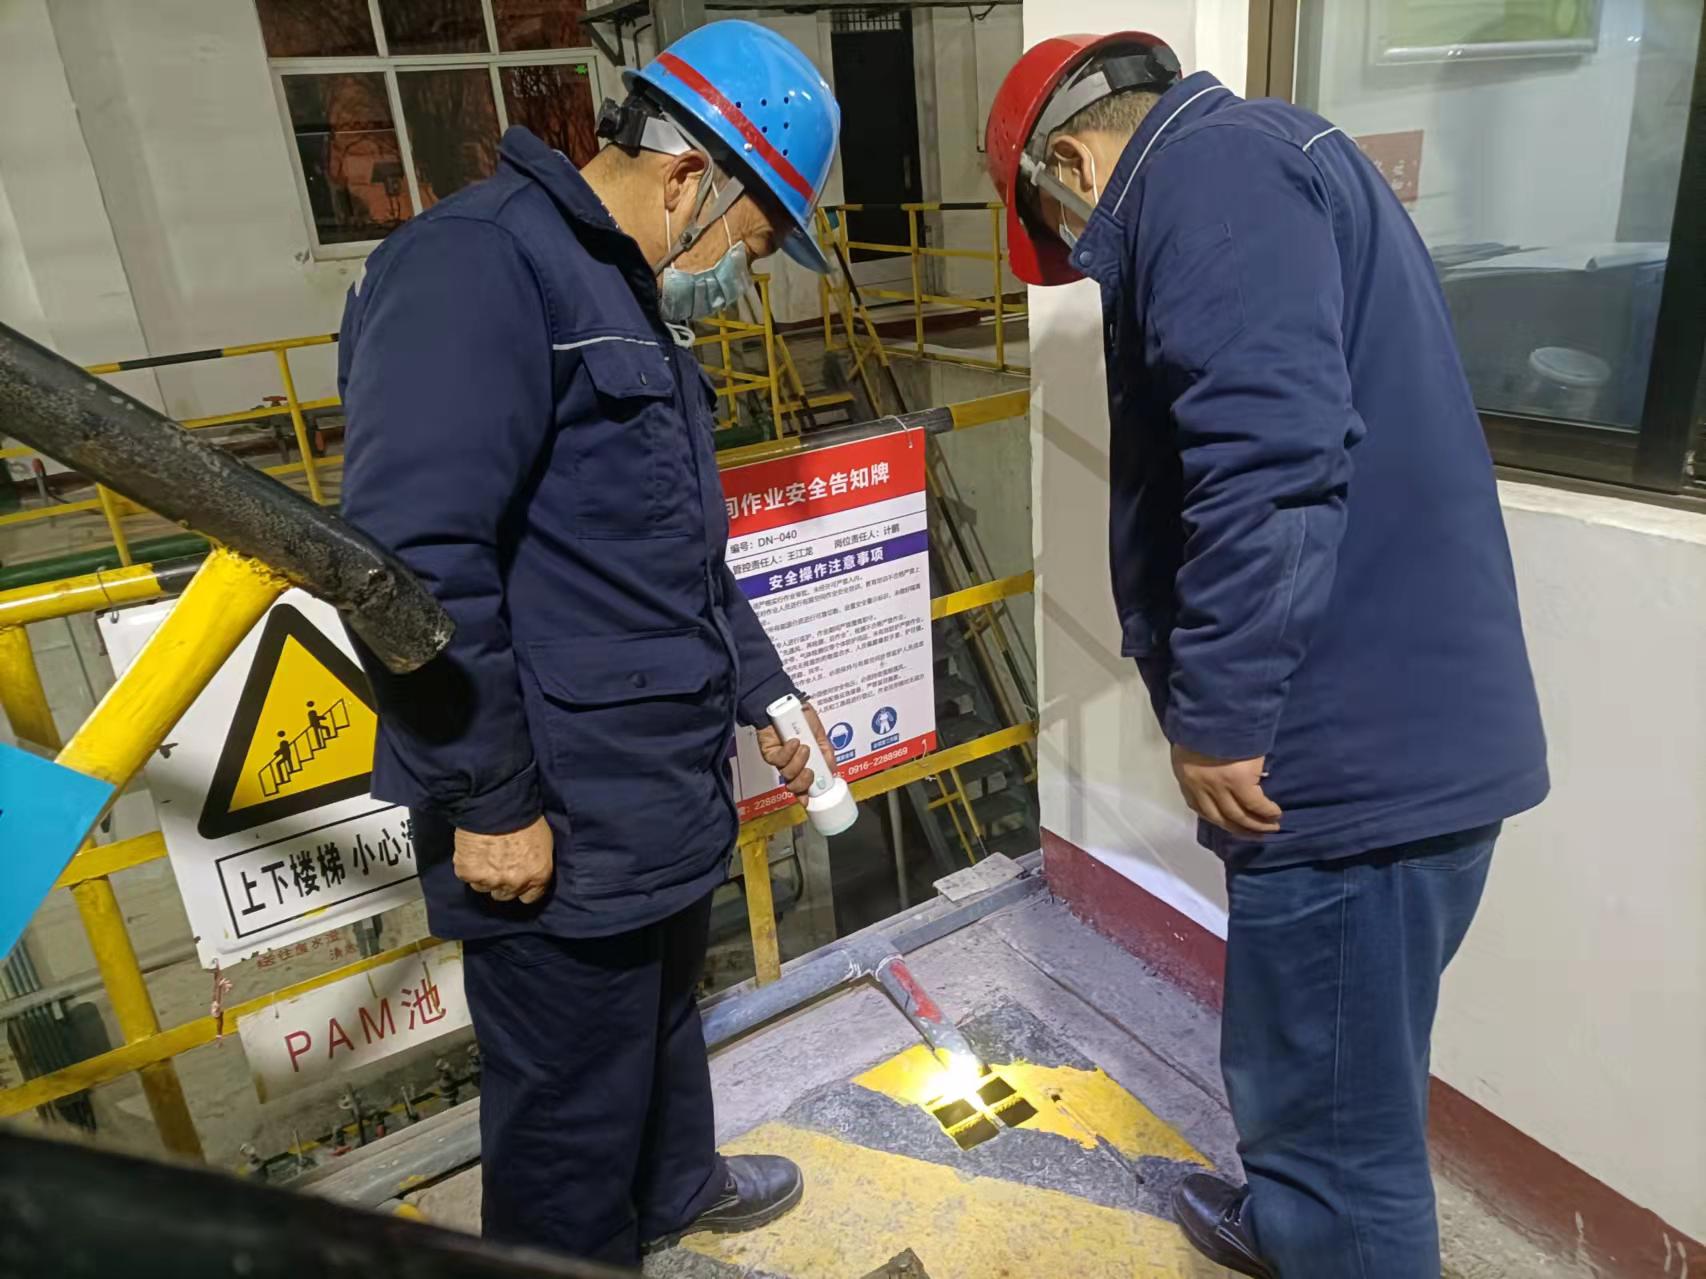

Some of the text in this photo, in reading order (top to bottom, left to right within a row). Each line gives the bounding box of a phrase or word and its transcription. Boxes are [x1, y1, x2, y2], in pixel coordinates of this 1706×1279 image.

[768, 546, 884, 591] 安全操作注意事项
[242, 842, 346, 915] 上下楼梯
[284, 979, 447, 1073] PAM池
